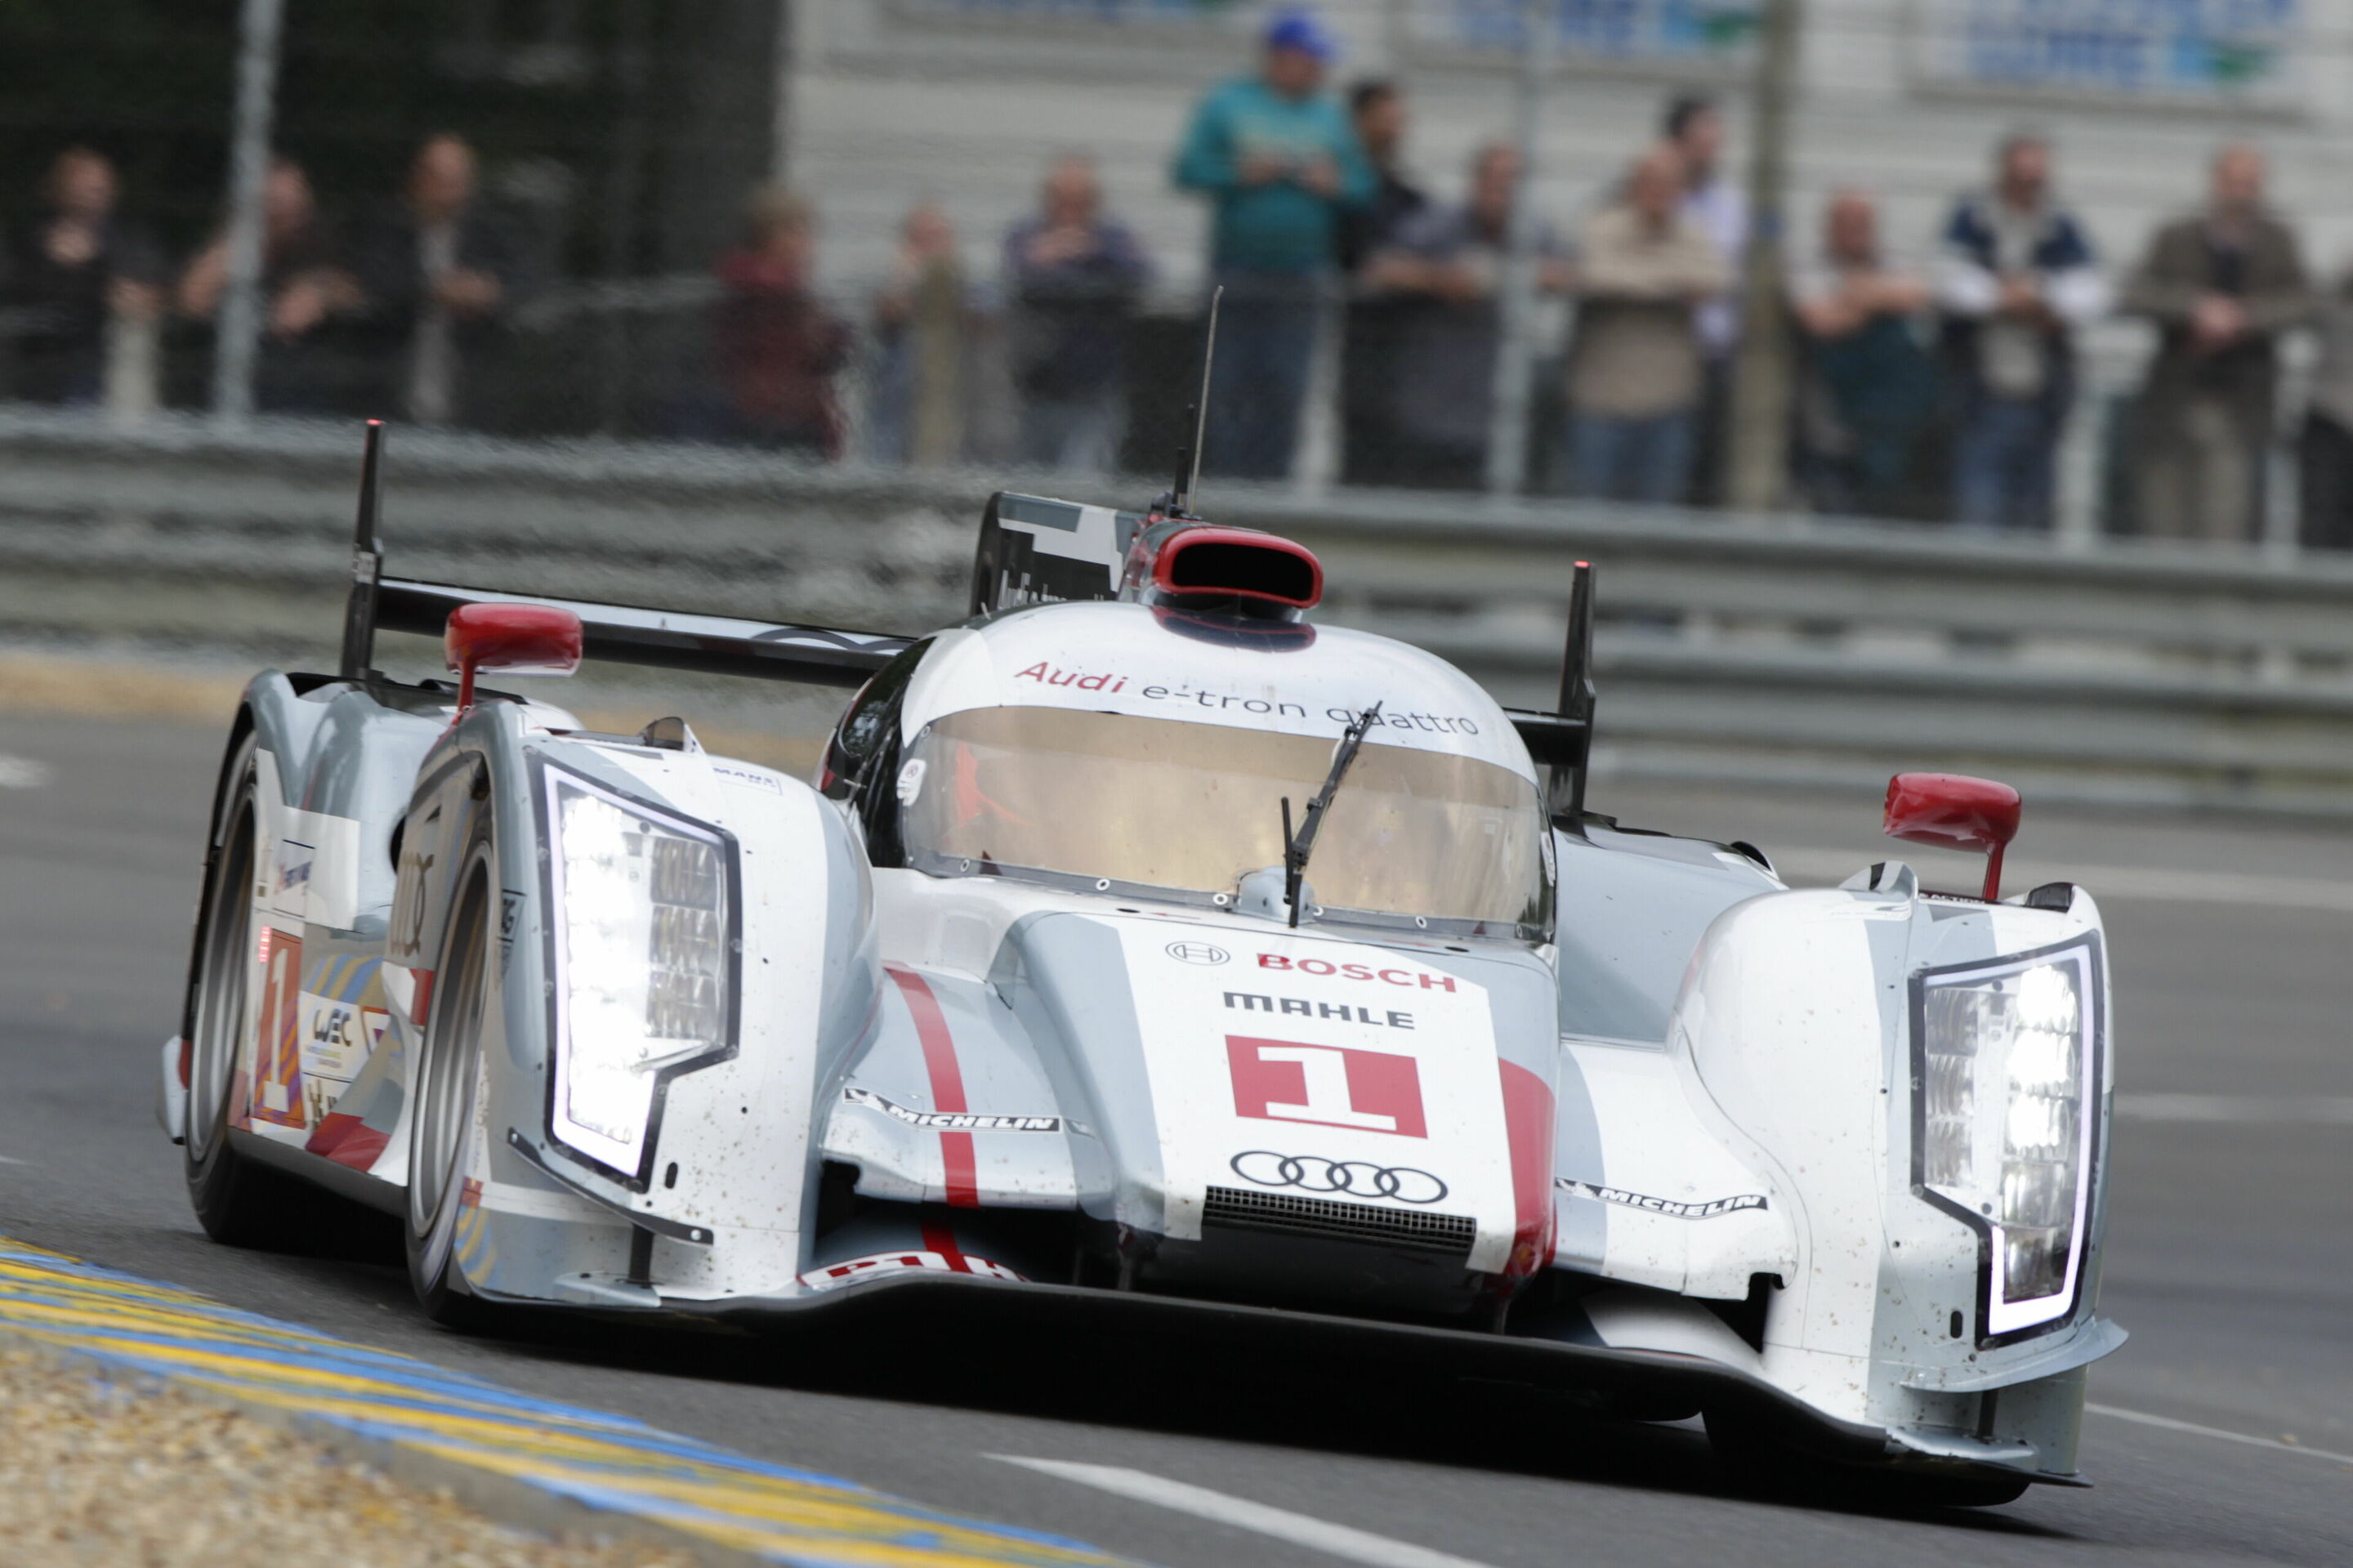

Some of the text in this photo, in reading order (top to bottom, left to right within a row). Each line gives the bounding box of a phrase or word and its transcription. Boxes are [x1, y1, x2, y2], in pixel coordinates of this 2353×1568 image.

[1014, 662, 1129, 693] Audi
[1141, 686, 1306, 717] e-tron
[1257, 953, 1458, 993] BOSCH
[1222, 991, 1415, 1030] MAHLE
[1257, 1046, 1397, 1132] 1
[888, 1104, 1056, 1131] MICHELIN
[1598, 1188, 1761, 1217] MICHELIN
